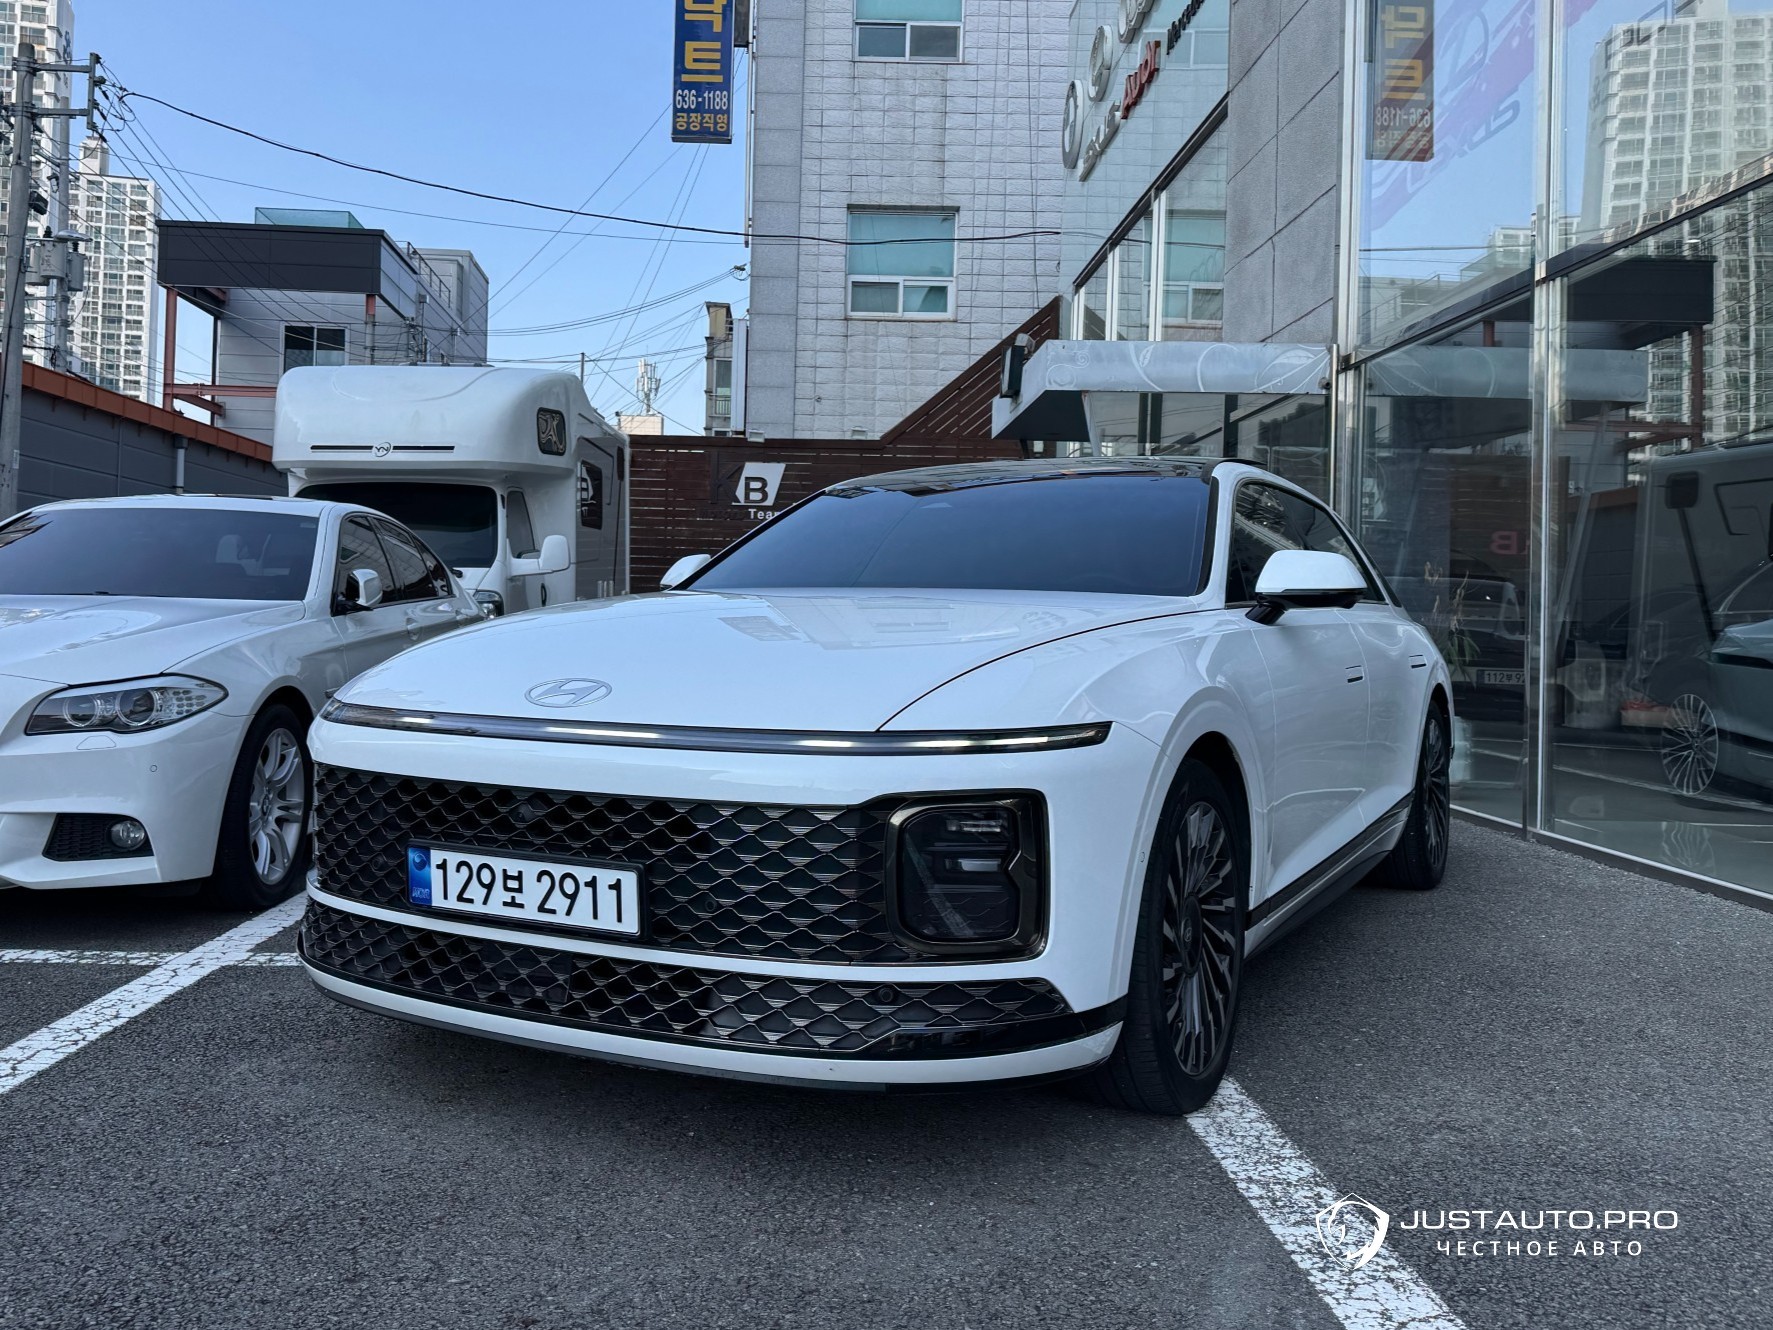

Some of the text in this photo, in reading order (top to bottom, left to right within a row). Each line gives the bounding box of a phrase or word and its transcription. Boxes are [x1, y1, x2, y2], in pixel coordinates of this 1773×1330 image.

[675, 89, 728, 110] 636-1188
[1121, 40, 1161, 119] Audi
[676, 112, 728, 132] 공장직영
[435, 858, 623, 923] 129보 2911
